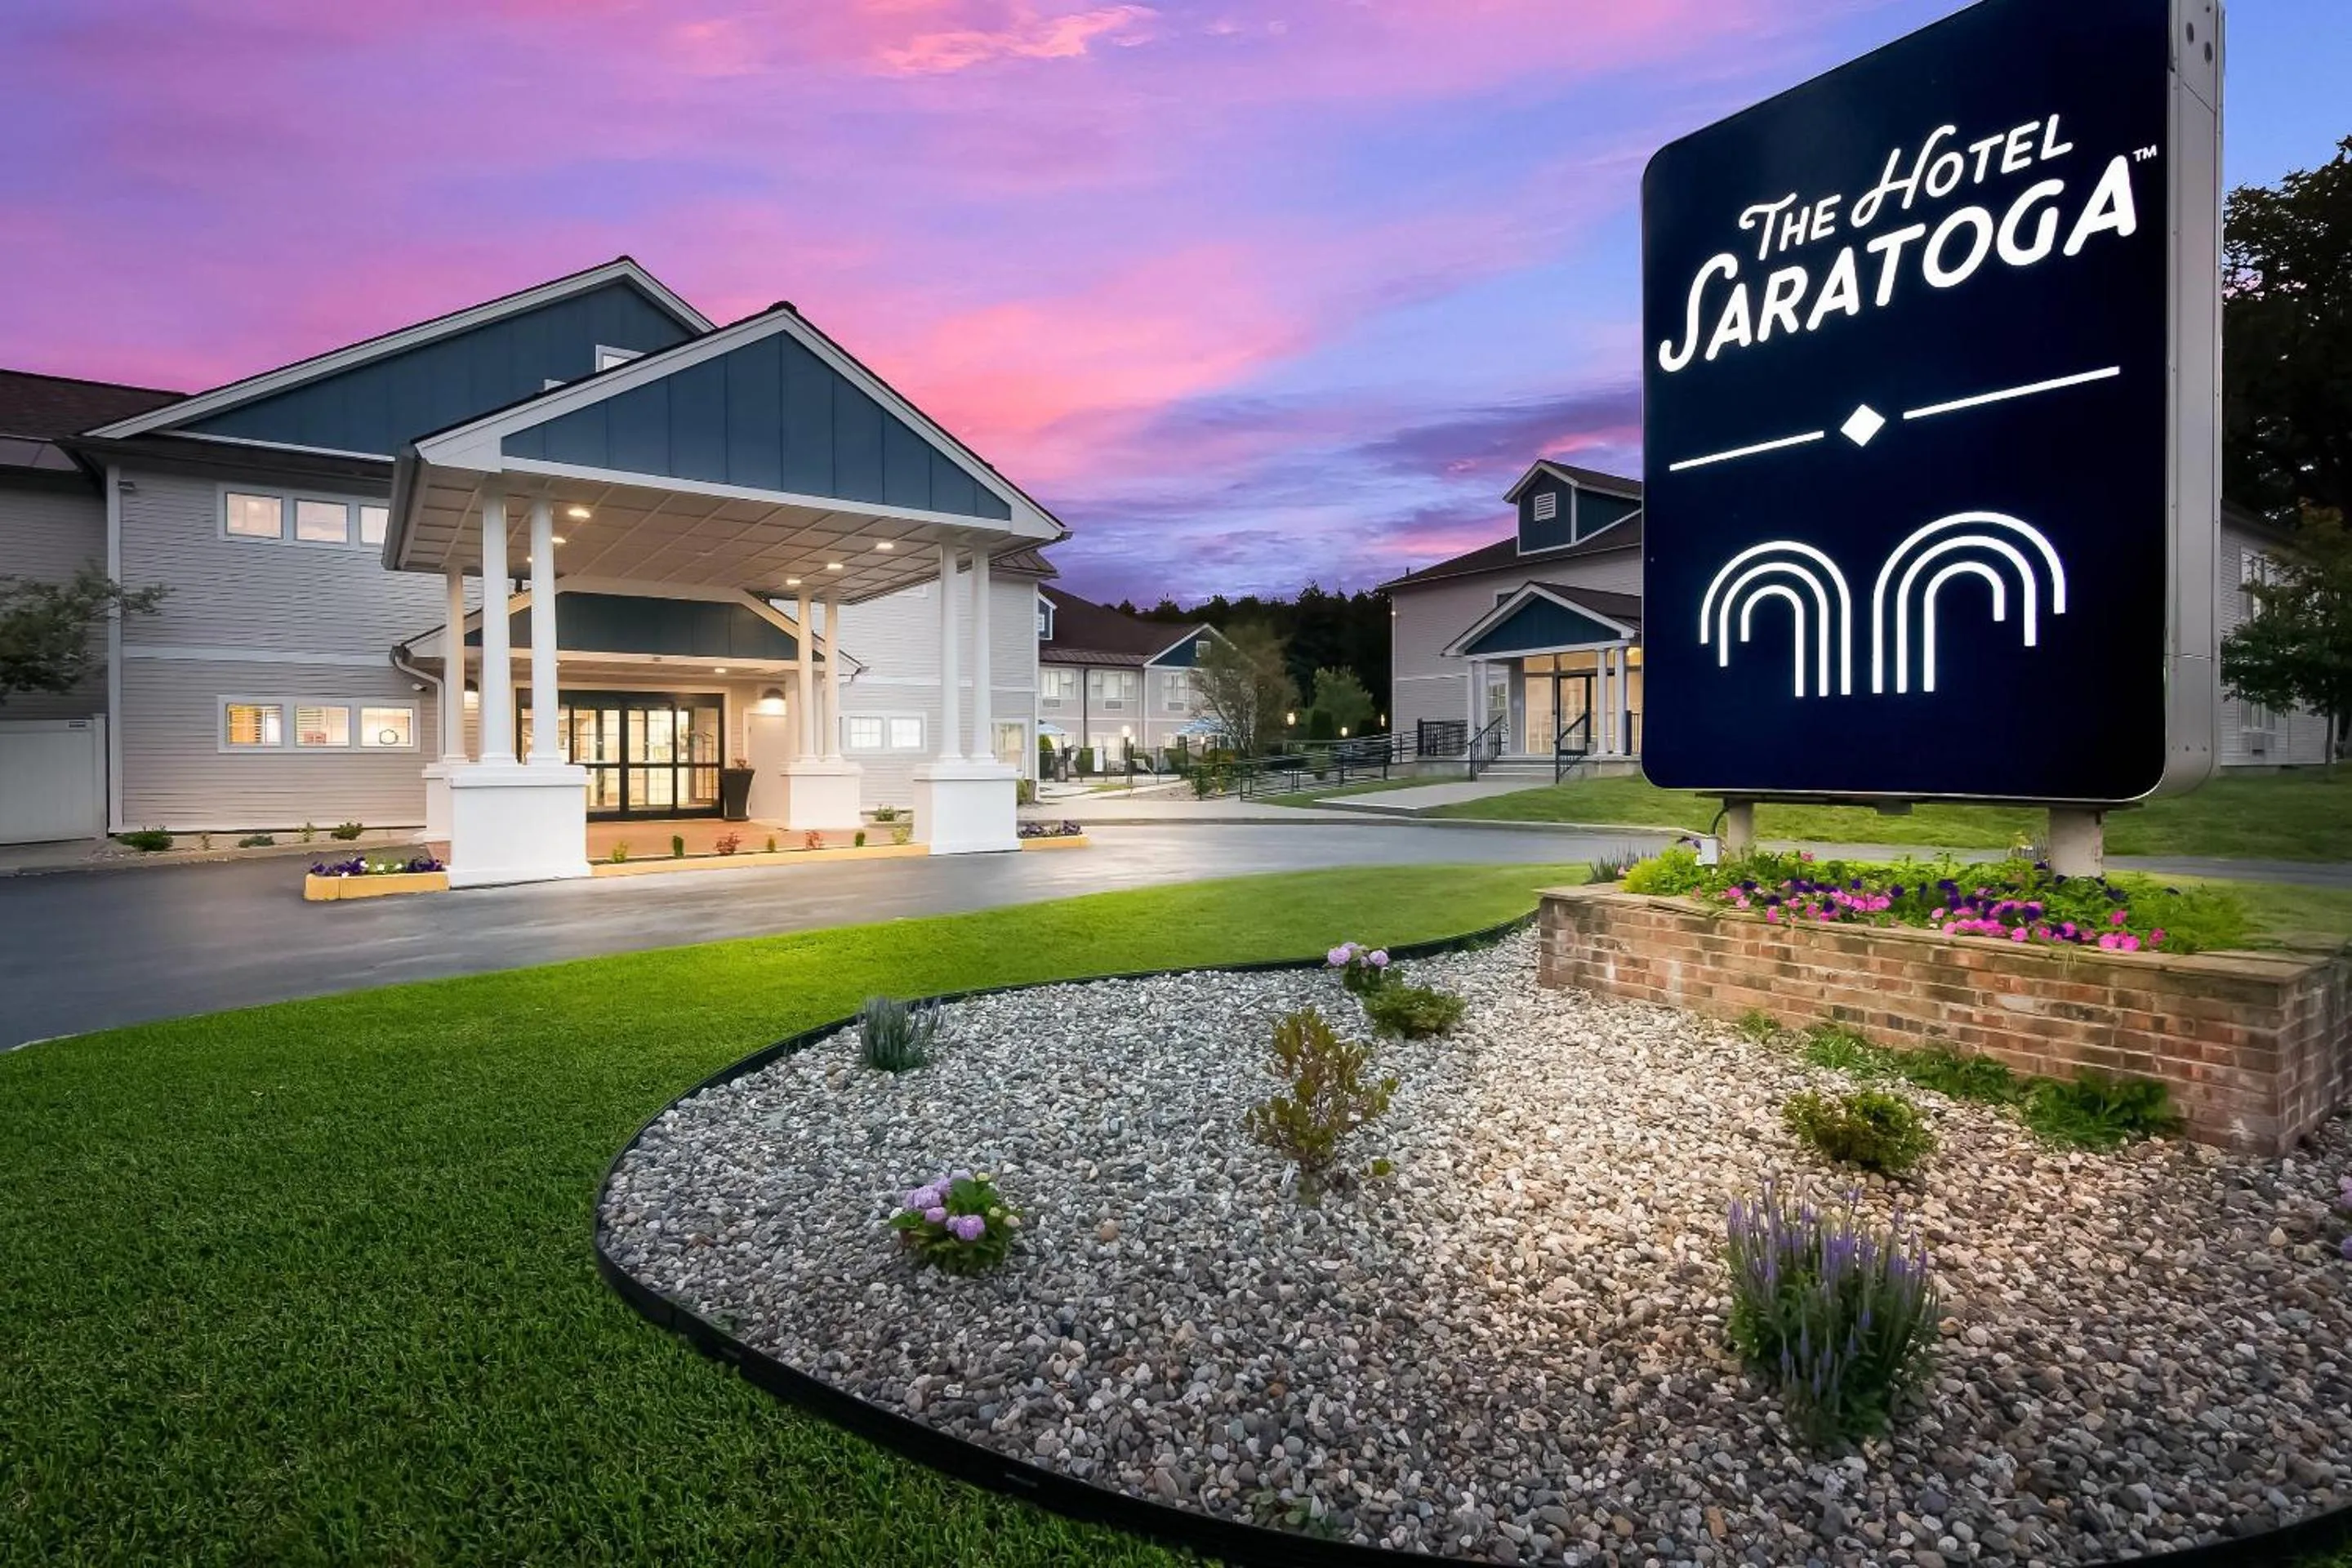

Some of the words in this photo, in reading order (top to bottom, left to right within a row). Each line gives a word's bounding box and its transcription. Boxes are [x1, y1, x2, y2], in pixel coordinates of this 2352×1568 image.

[1658, 154, 2136, 372] SARATOGA
[1739, 192, 1842, 261] THE
[1851, 114, 2074, 228] HOTEL
